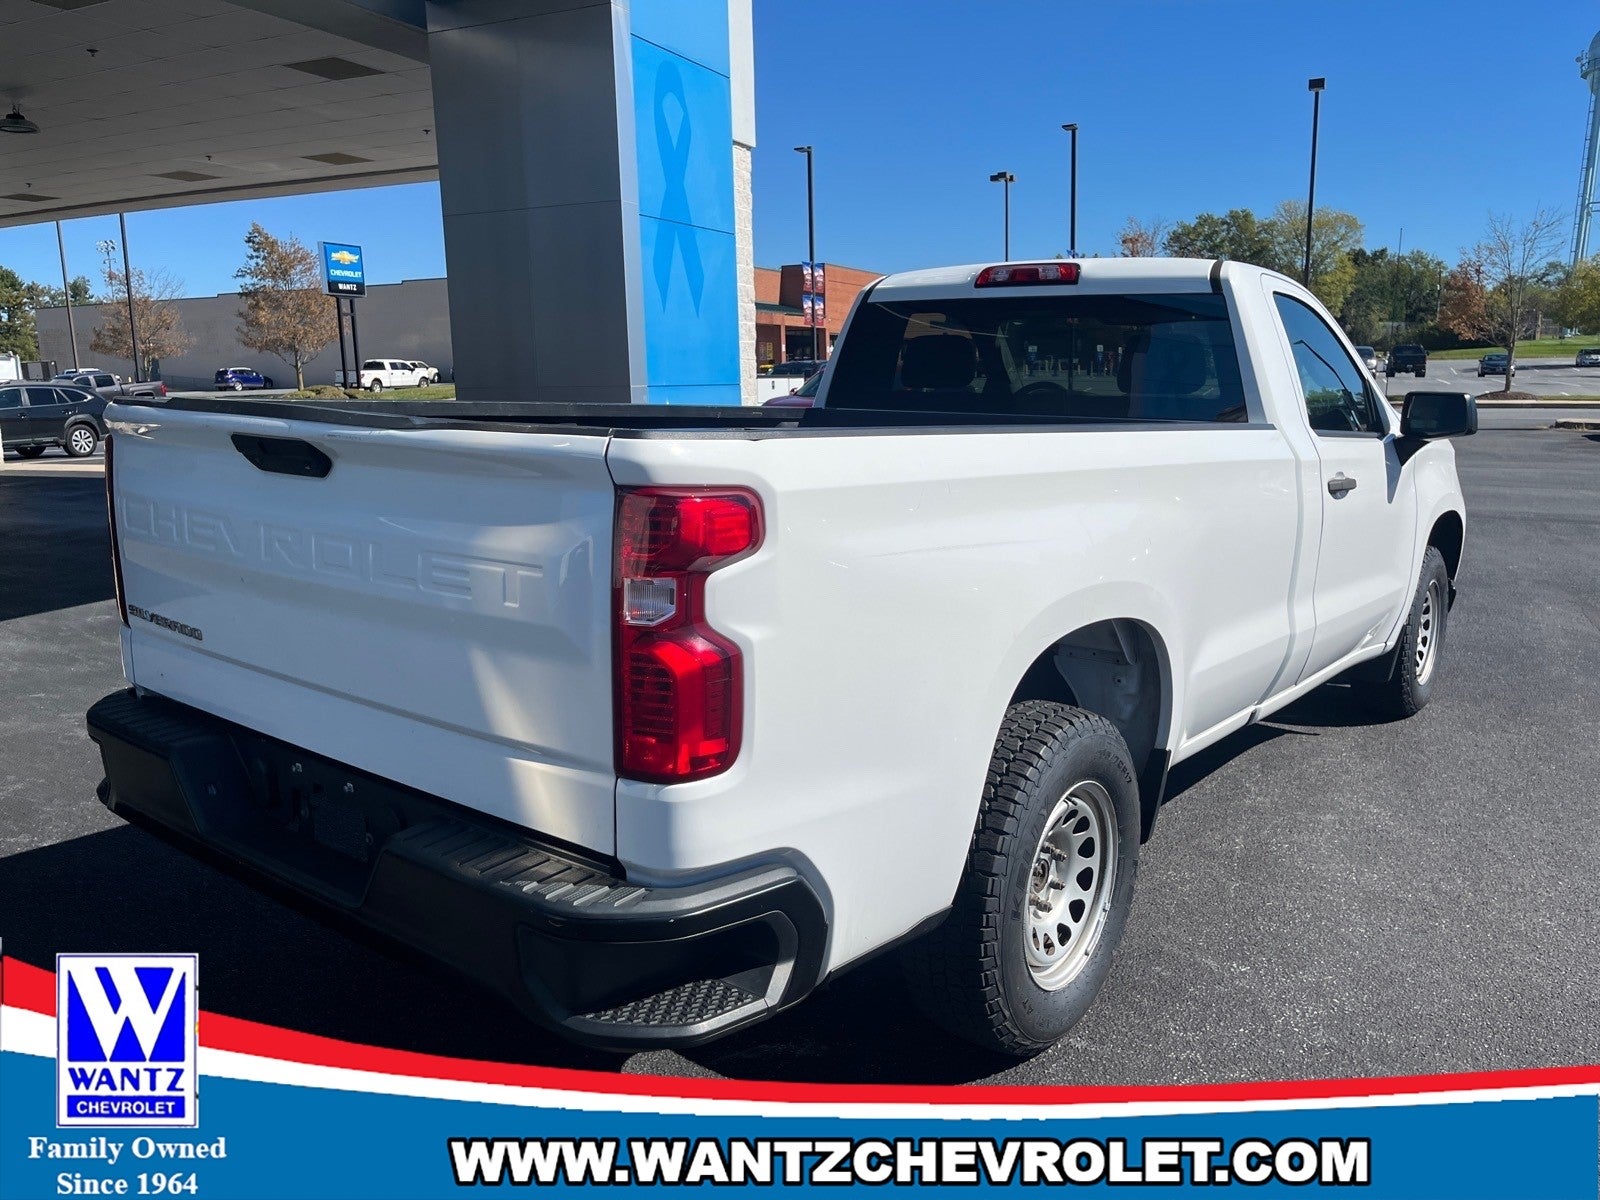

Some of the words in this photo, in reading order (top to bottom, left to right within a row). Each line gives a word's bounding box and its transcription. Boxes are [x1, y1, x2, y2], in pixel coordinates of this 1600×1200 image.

[330, 269, 362, 277] CHEVROLET
[338, 283, 357, 291] WANTZ
[119, 494, 543, 608] CHEVROLET
[128, 604, 203, 641] SILVERADO
